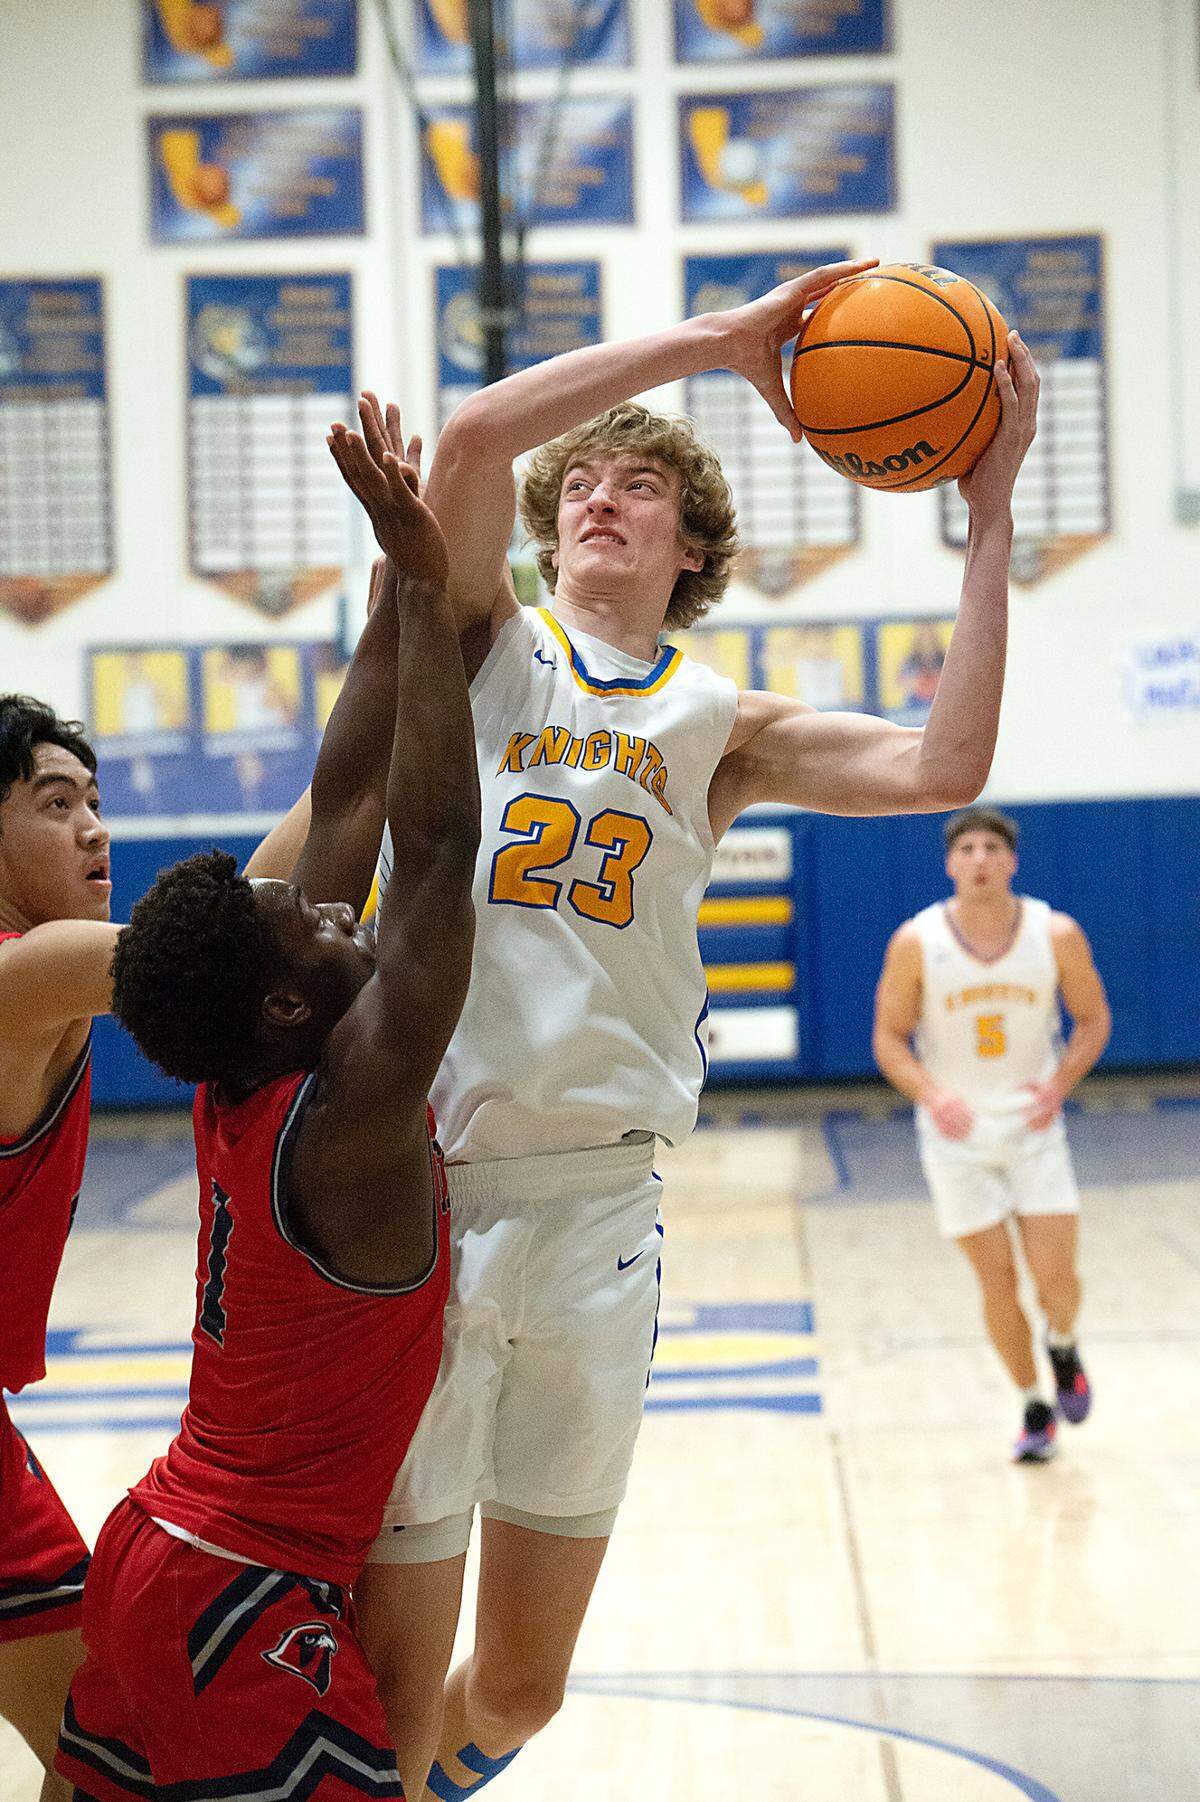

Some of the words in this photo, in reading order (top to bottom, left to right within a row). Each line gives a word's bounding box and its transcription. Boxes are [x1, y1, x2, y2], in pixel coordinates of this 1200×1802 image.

[495, 725, 673, 816] KNIGHTS
[487, 791, 654, 930] 23
[976, 1015, 1007, 1058] 5
[199, 1176, 235, 1350] 1
